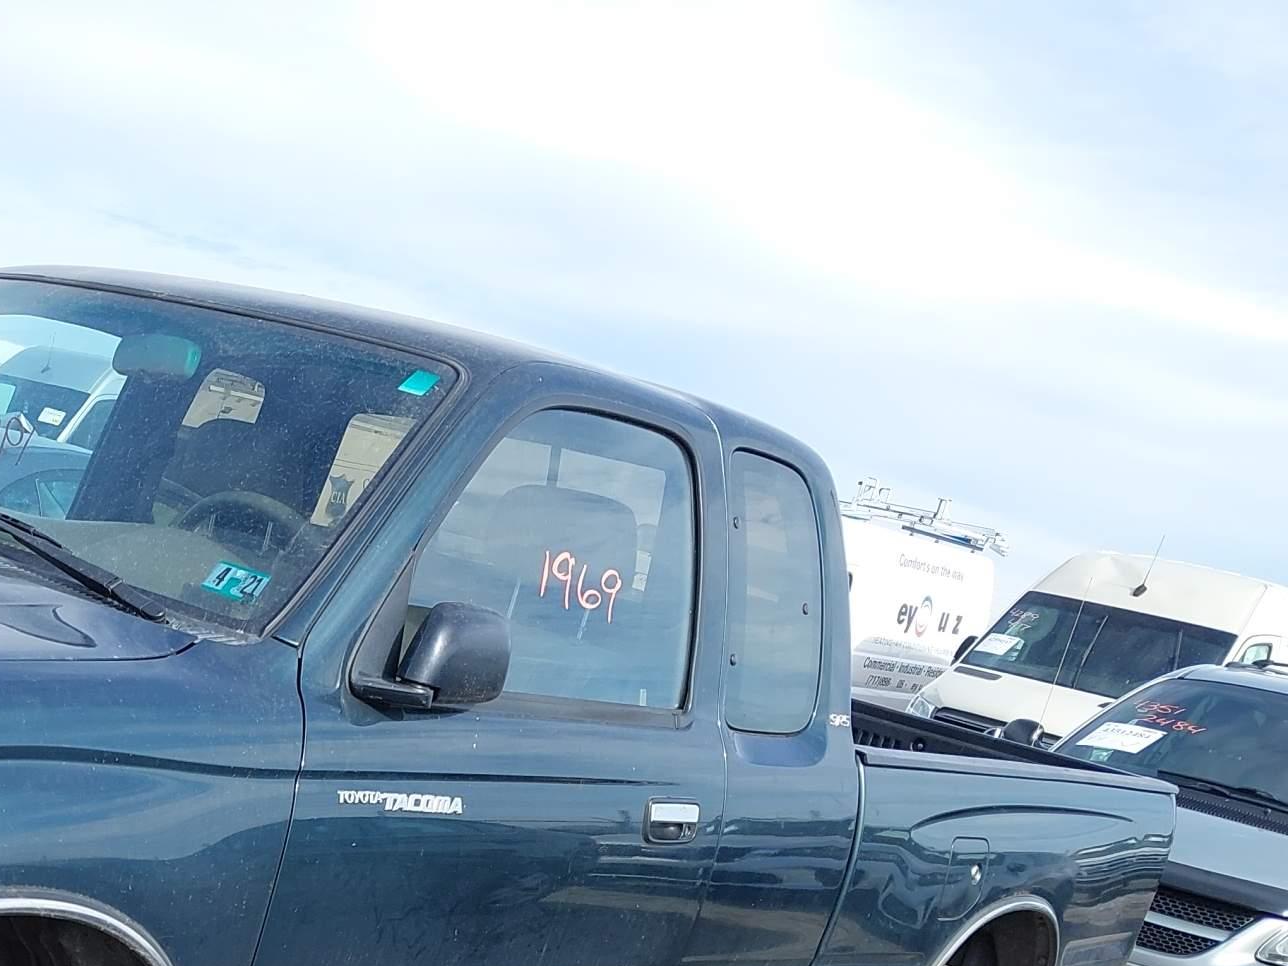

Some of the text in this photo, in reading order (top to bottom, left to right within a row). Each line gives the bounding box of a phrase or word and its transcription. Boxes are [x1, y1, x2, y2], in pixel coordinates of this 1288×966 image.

[213, 567, 264, 596] 4 21
[539, 550, 623, 625] 1969
[337, 790, 462, 814] TOYOTA TACOMA
